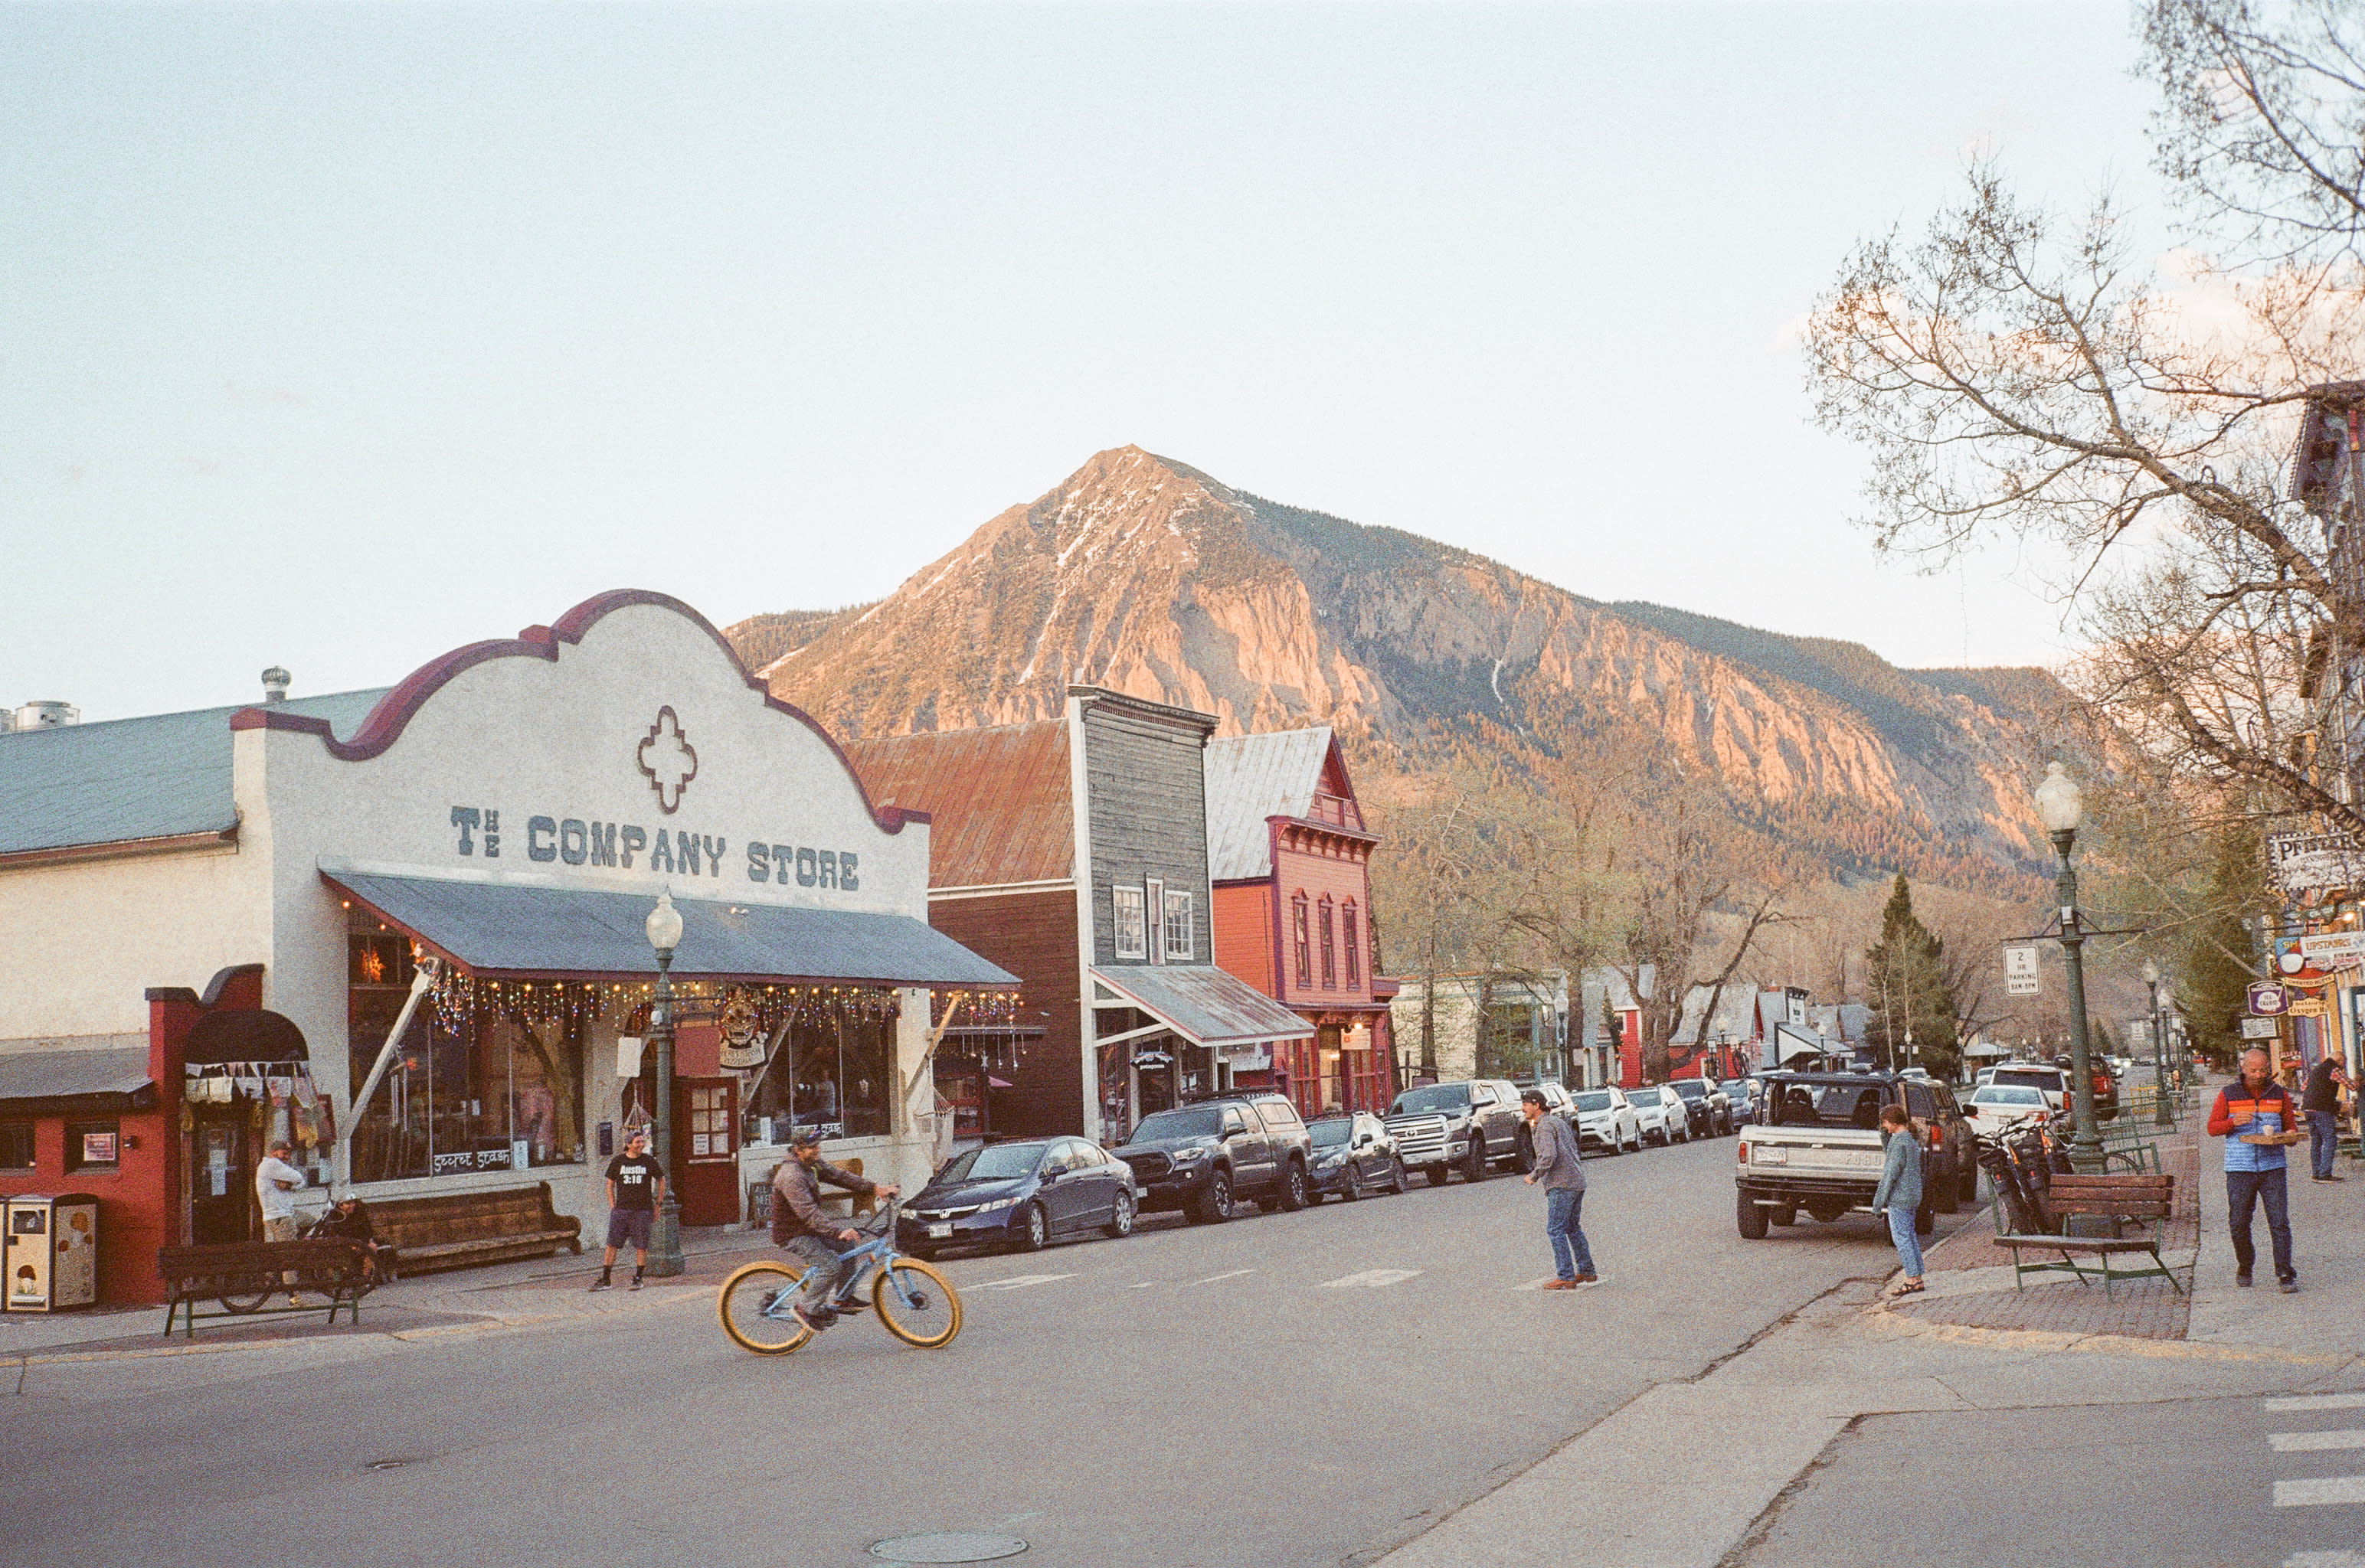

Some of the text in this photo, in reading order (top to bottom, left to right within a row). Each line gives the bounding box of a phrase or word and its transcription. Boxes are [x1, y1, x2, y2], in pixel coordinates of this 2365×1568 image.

[528, 815, 726, 877] COMPANY
[747, 841, 859, 891] STORE
[2305, 939, 2351, 950] UPSTAIRS
[2017, 952, 2023, 961] 2
[1843, 1153, 1882, 1165] FORD
[620, 1165, 646, 1174] Austin
[623, 1174, 642, 1184] 3:16
